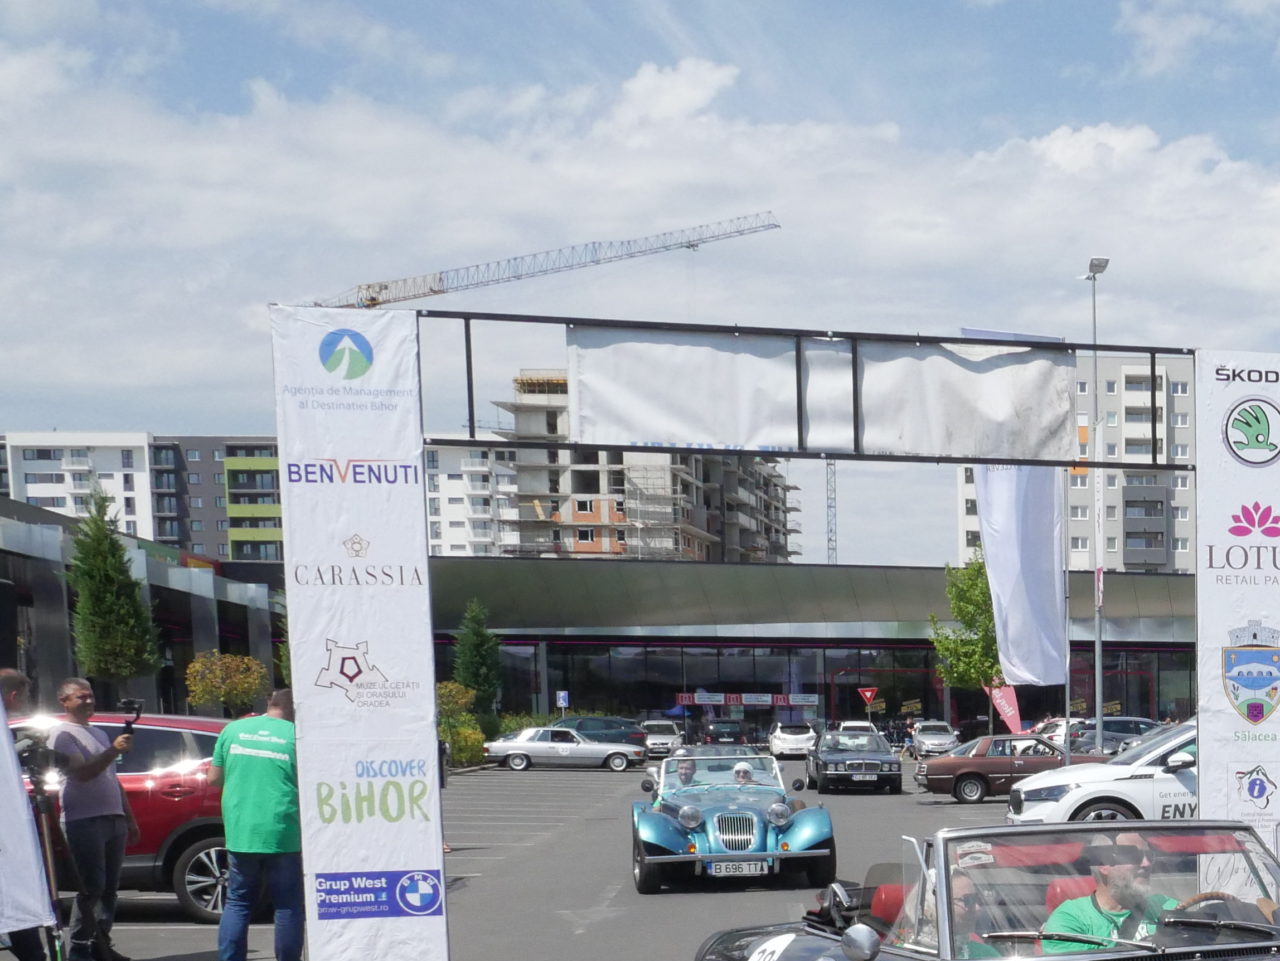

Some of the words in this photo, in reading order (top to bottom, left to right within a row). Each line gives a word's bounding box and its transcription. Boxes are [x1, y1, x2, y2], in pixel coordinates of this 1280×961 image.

[326, 386, 341, 395] de
[342, 386, 413, 398] Management
[298, 400, 308, 409] al
[371, 401, 399, 411] Bihor
[287, 459, 419, 485] BENVENUTI
[294, 565, 424, 586] CARASSIA
[1216, 574, 1259, 585] RETAIL
[356, 700, 391, 708] ORADEA
[715, 863, 722, 873] B
[725, 863, 744, 873] 696
[316, 878, 350, 891] Grup
[351, 877, 387, 888] West
[316, 891, 375, 903] Premium
